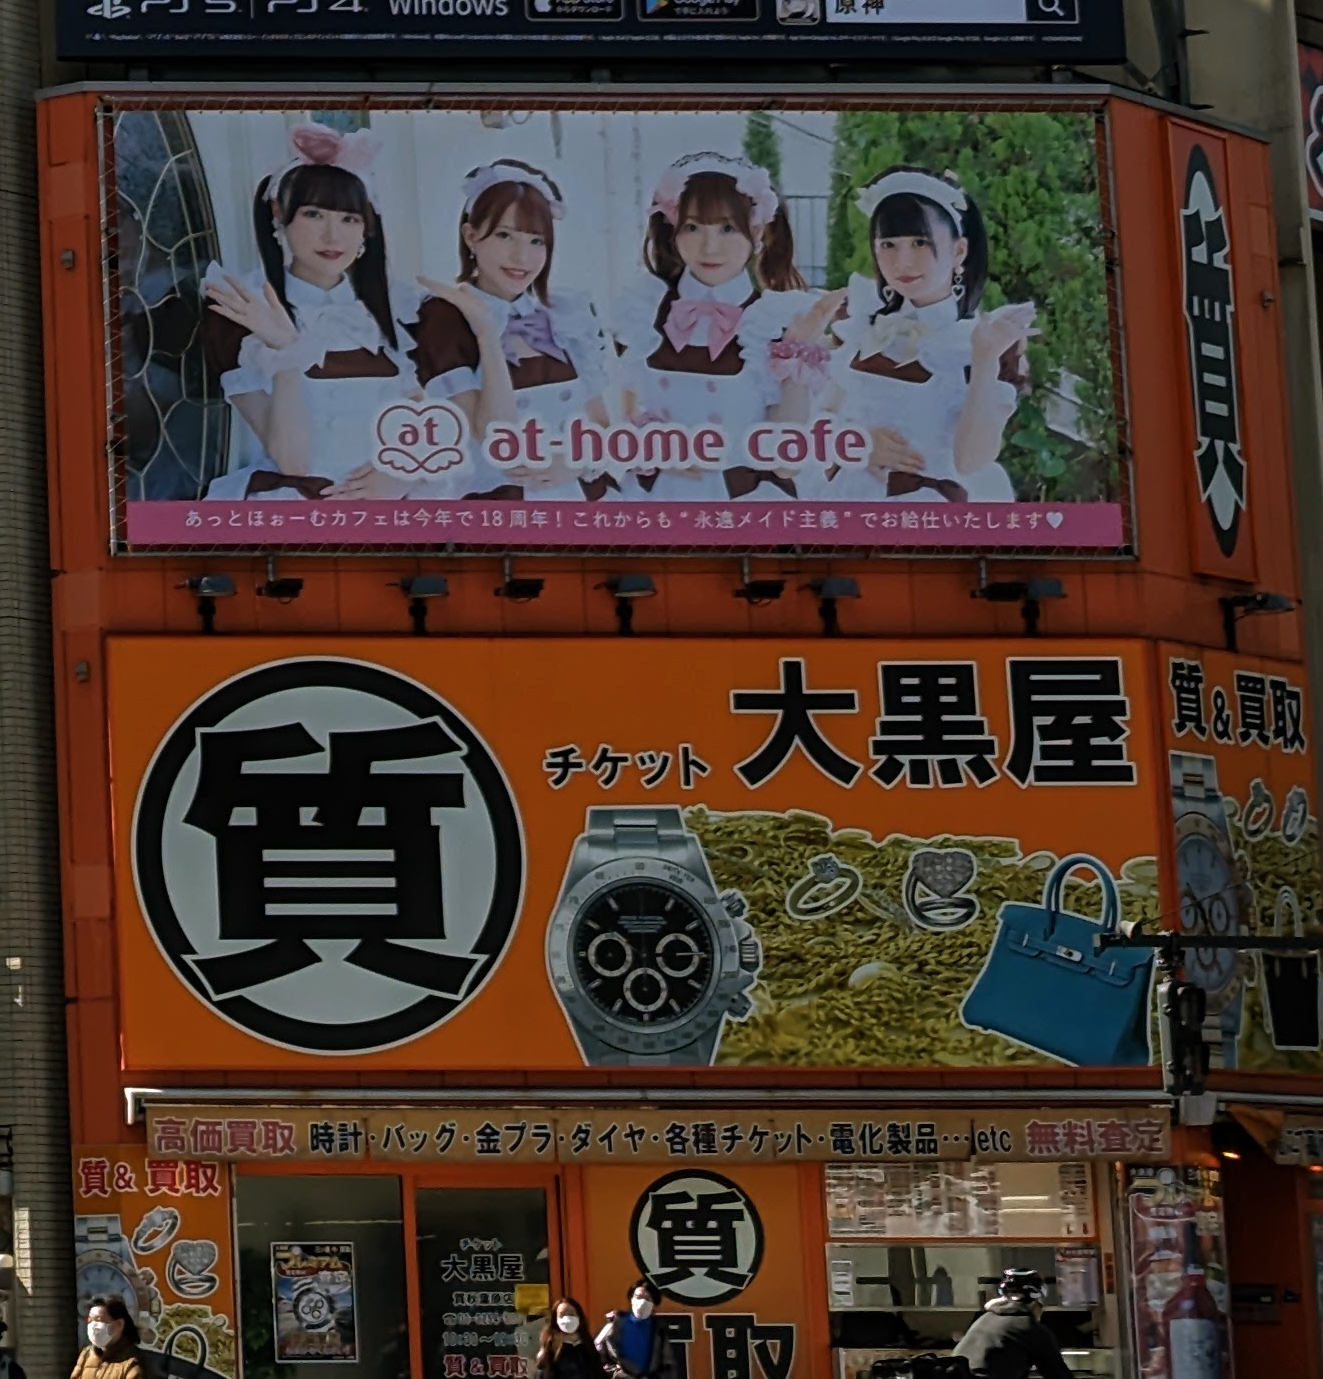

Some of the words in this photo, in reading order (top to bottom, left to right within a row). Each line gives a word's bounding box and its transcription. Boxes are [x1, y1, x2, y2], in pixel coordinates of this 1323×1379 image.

[398, 416, 440, 448] at
[488, 417, 725, 464] at-home
[748, 418, 866, 464] cafe
[542, 741, 712, 790] チケット
[728, 656, 1138, 791] 大黒屋
[182, 715, 491, 1002] 質
[152, 1117, 296, 1155] 高価買取
[1025, 1118, 1165, 1156] 無料査定
[646, 1188, 753, 1290] 質
[440, 1253, 525, 1282] 大黒屋
